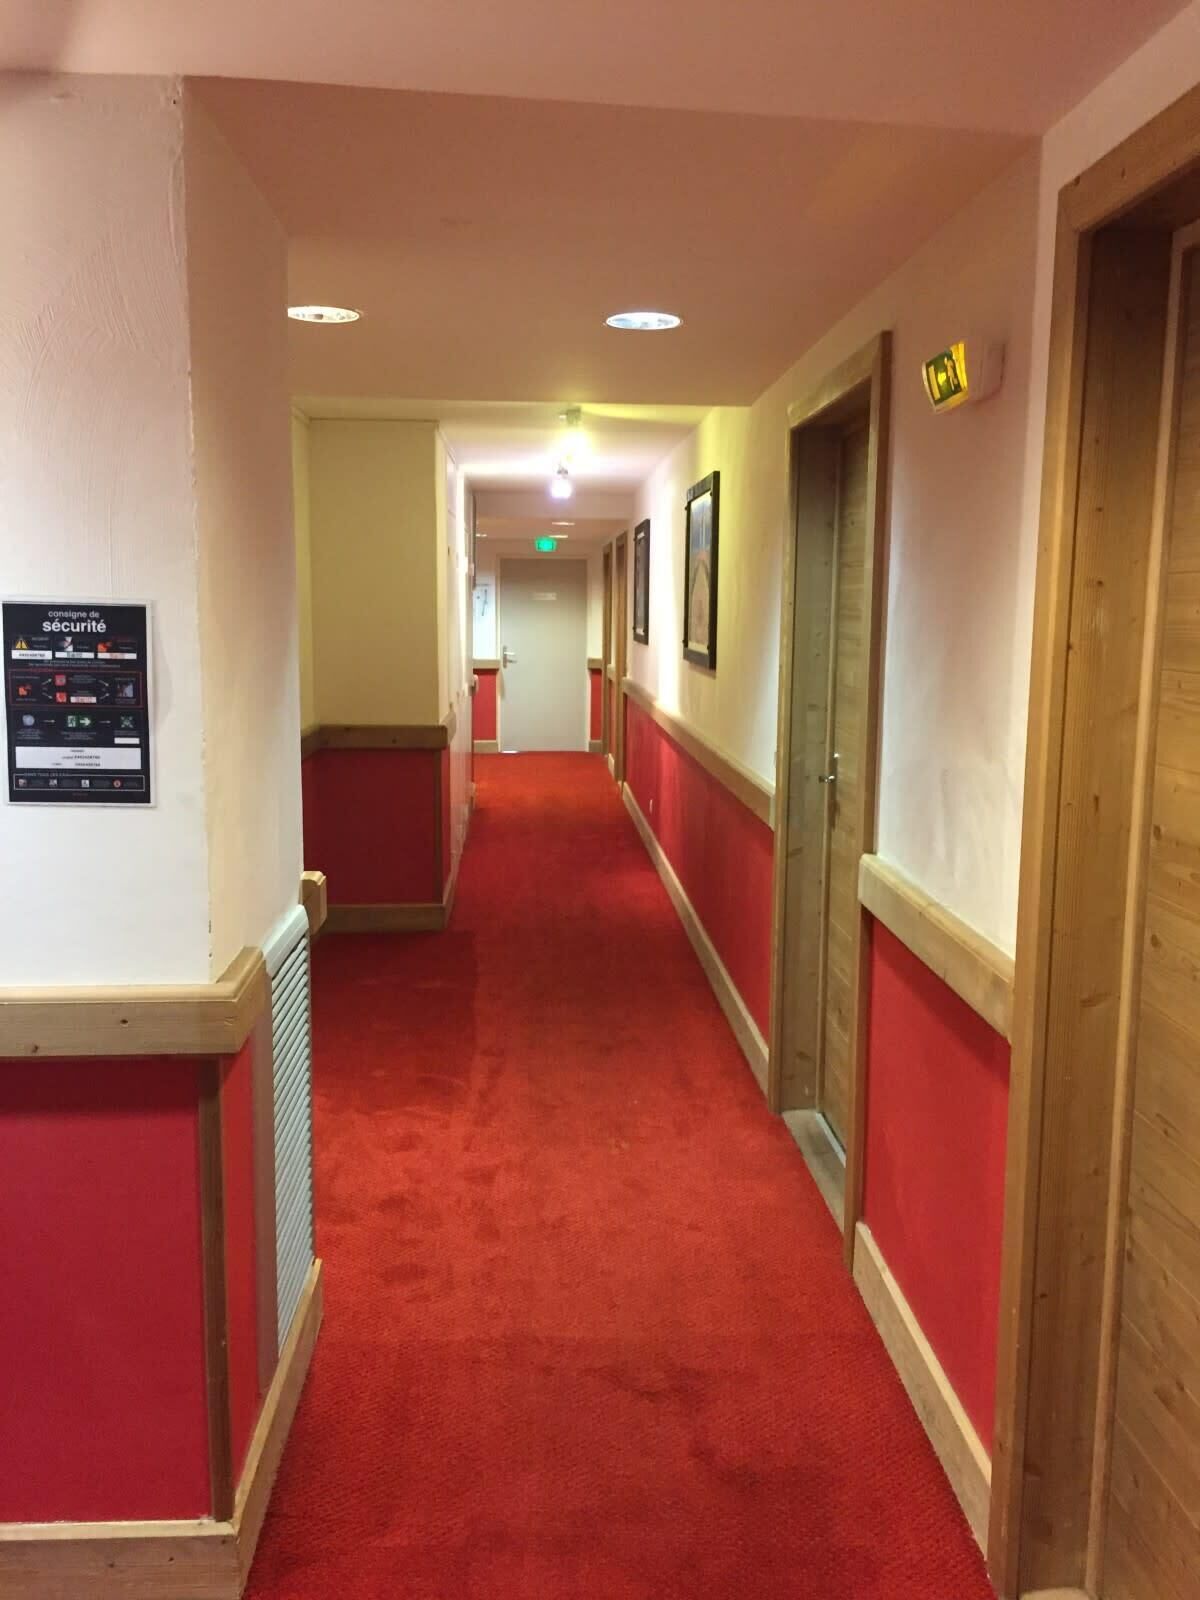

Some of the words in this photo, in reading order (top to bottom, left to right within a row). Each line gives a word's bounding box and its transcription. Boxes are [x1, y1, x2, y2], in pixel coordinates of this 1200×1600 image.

[48, 610, 87, 619] consigne
[89, 610, 100, 618] de
[42, 619, 107, 633] sécurité
